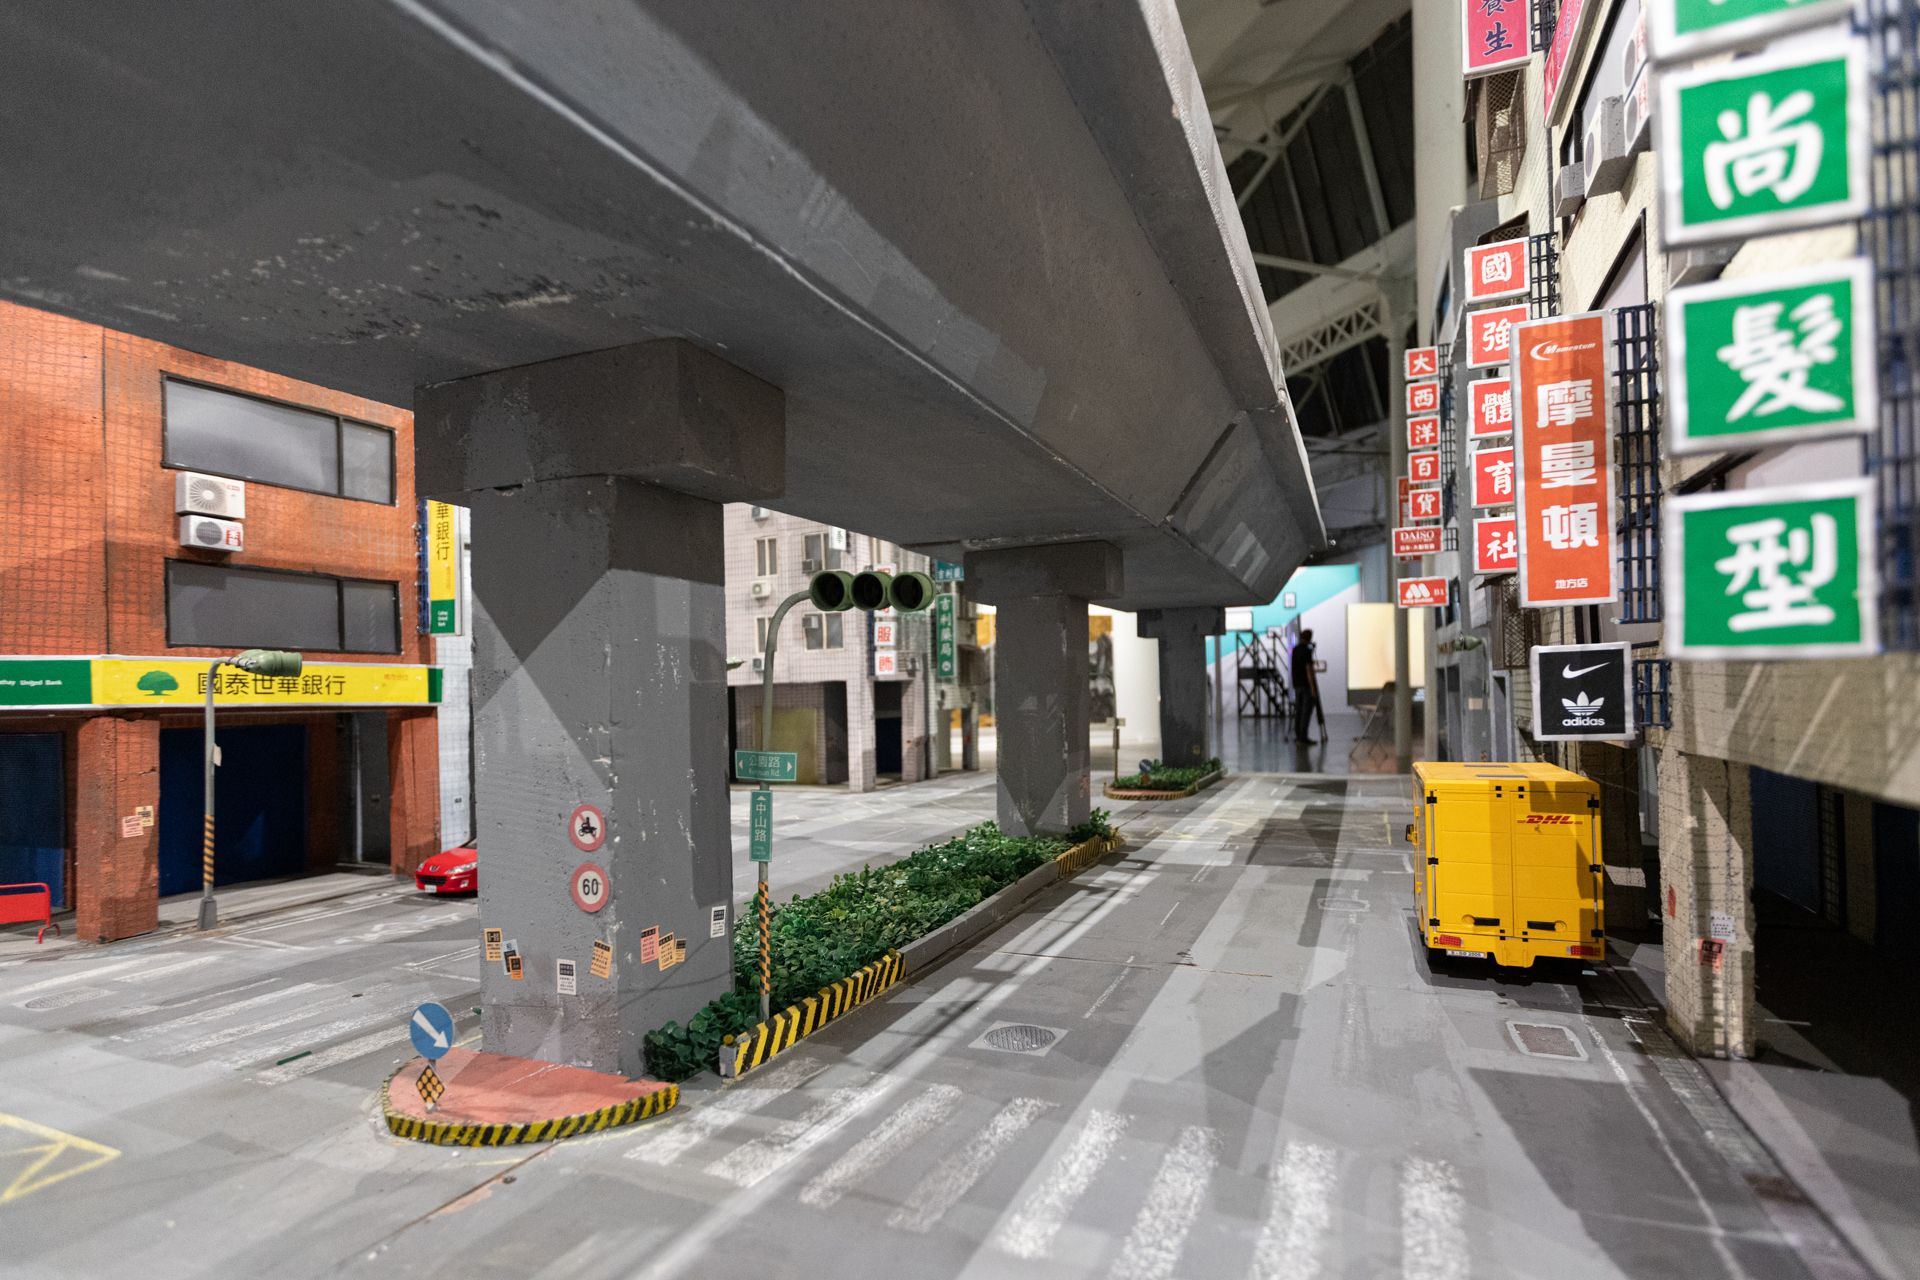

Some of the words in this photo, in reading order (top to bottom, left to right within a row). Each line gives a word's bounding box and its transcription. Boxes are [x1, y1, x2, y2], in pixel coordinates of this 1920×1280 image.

[1702, 0, 1844, 633] 尚髮型
[1543, 343, 1596, 355] Momentum
[1481, 252, 1517, 563] 國強體育社
[1412, 353, 1437, 515] 大西洋百貨
[1536, 378, 1599, 550] 摩曼頓
[1400, 530, 1435, 541] DAISO
[1555, 578, 1589, 589] 地方店
[198, 673, 346, 696] 國泰世華銀行
[1562, 716, 1606, 727] adidas
[755, 802, 767, 842] 中山路
[1526, 815, 1572, 825] DHL
[583, 878, 598, 896] 60
